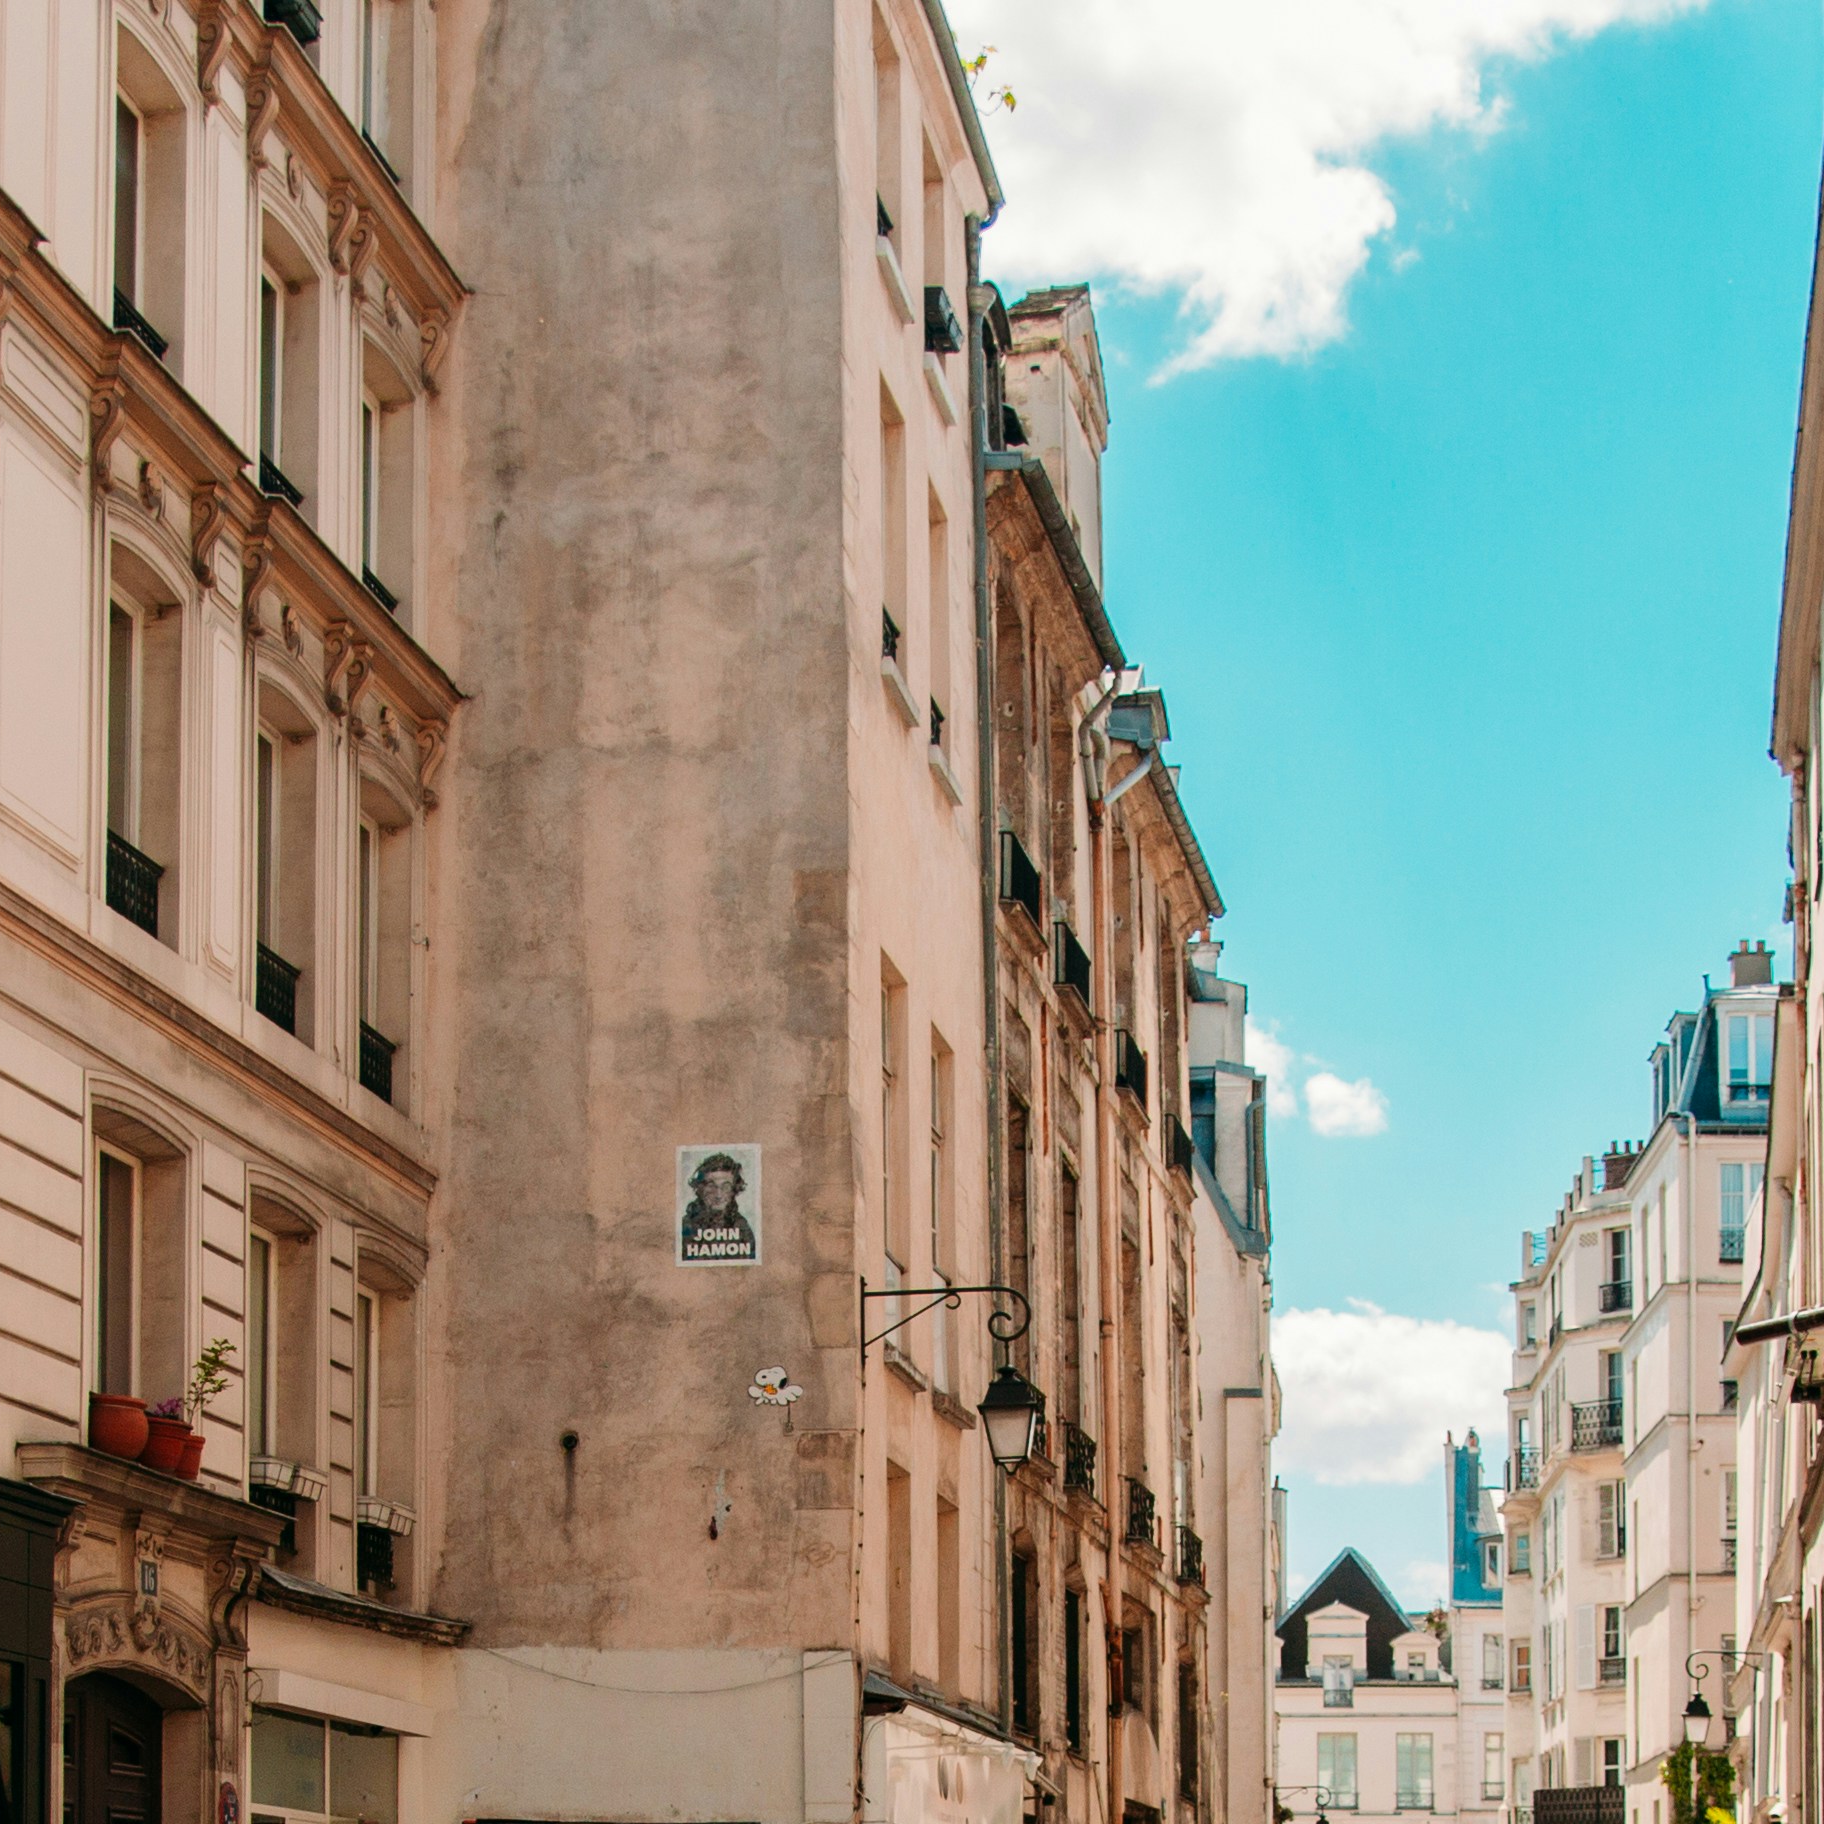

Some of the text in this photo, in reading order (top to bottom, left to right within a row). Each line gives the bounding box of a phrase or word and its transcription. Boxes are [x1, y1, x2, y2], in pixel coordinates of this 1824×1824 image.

[693, 1227, 740, 1241] JOHN
[686, 1242, 751, 1257] HAMON
[144, 1565, 155, 1591] 16
